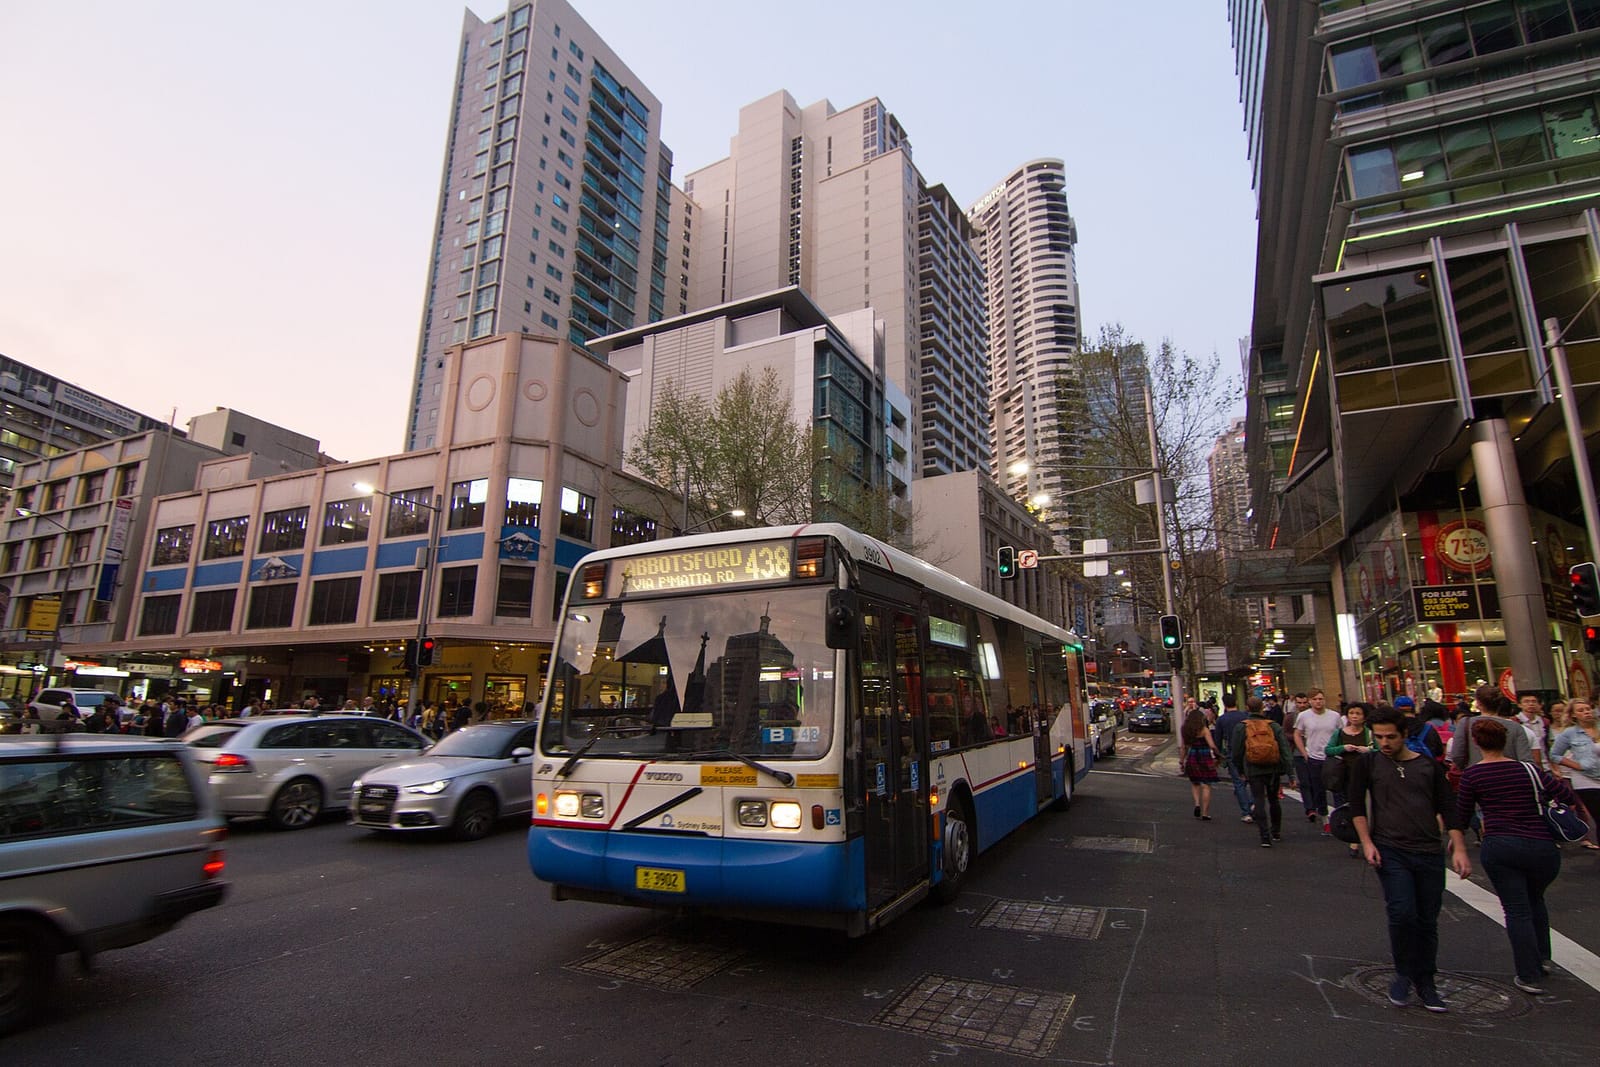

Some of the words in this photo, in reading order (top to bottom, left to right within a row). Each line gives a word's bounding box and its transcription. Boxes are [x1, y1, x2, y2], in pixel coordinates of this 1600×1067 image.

[624, 548, 743, 577] ABBOTSFORD
[745, 545, 791, 579] 438
[864, 546, 881, 565] 3902
[632, 579, 655, 591] VIA
[716, 570, 735, 584] RD
[770, 729, 784, 741] B
[644, 771, 684, 781] VOLVO
[702, 775, 729, 783] SIGNAL
[730, 775, 757, 783] DRIVER
[677, 821, 700, 830] Sydney
[701, 822, 721, 831] Buses
[653, 871, 679, 887] 3902
